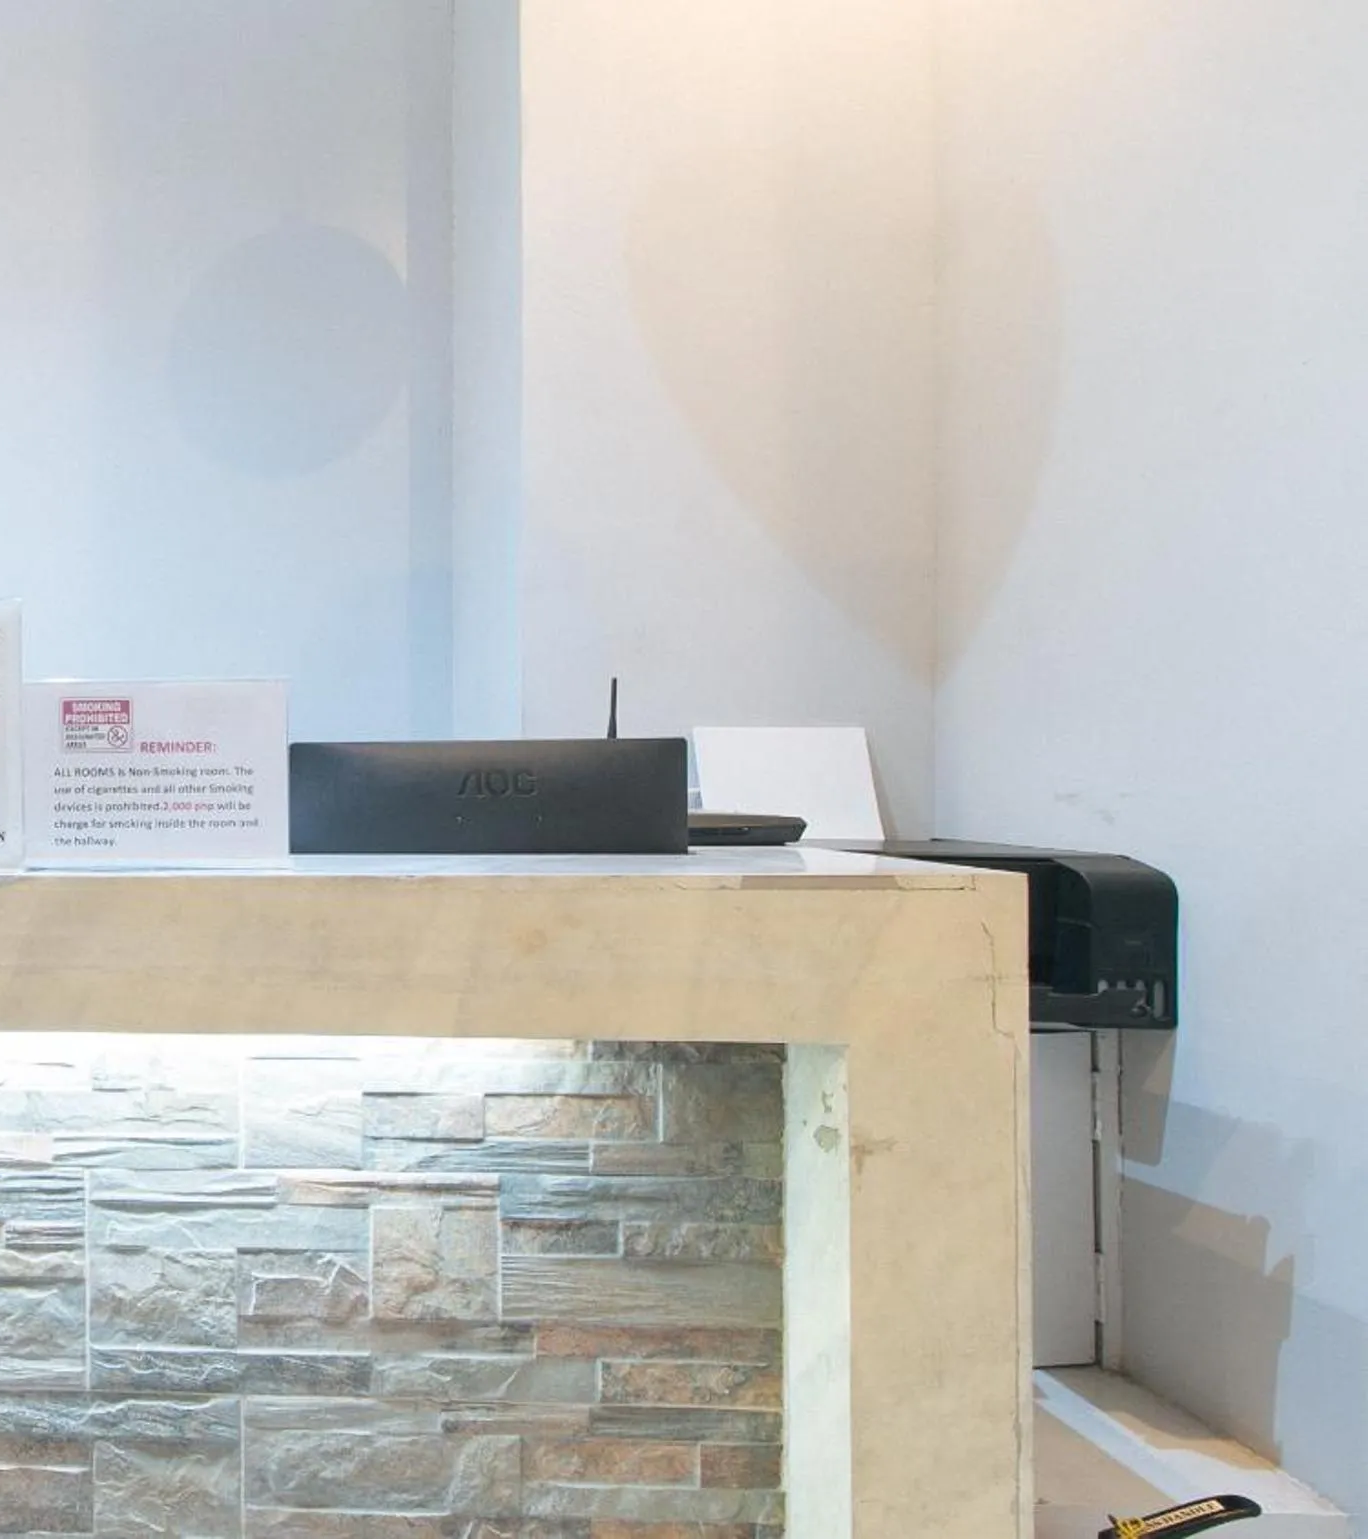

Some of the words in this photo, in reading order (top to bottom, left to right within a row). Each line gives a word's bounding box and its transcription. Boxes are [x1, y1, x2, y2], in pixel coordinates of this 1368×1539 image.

[72, 701, 121, 712] SMOKING
[65, 712, 129, 724] PROHIBITED
[140, 741, 217, 753] REMINDER:
[54, 767, 72, 777] ALL
[74, 767, 115, 777] ROOMS
[234, 766, 254, 776] The
[74, 785, 85, 794] of
[87, 785, 138, 796] cigarettes
[142, 785, 161, 794] and
[164, 785, 176, 794] all
[178, 784, 206, 793] other
[209, 783, 254, 796] Smoking
[54, 802, 93, 812] devices
[217, 801, 236, 810] will
[238, 801, 251, 810] be
[54, 819, 89, 830] charge
[91, 818, 106, 828] for
[108, 819, 152, 830] smoking
[155, 818, 186, 828] inside
[188, 818, 206, 828] the
[209, 819, 236, 828] room
[240, 818, 259, 827] and
